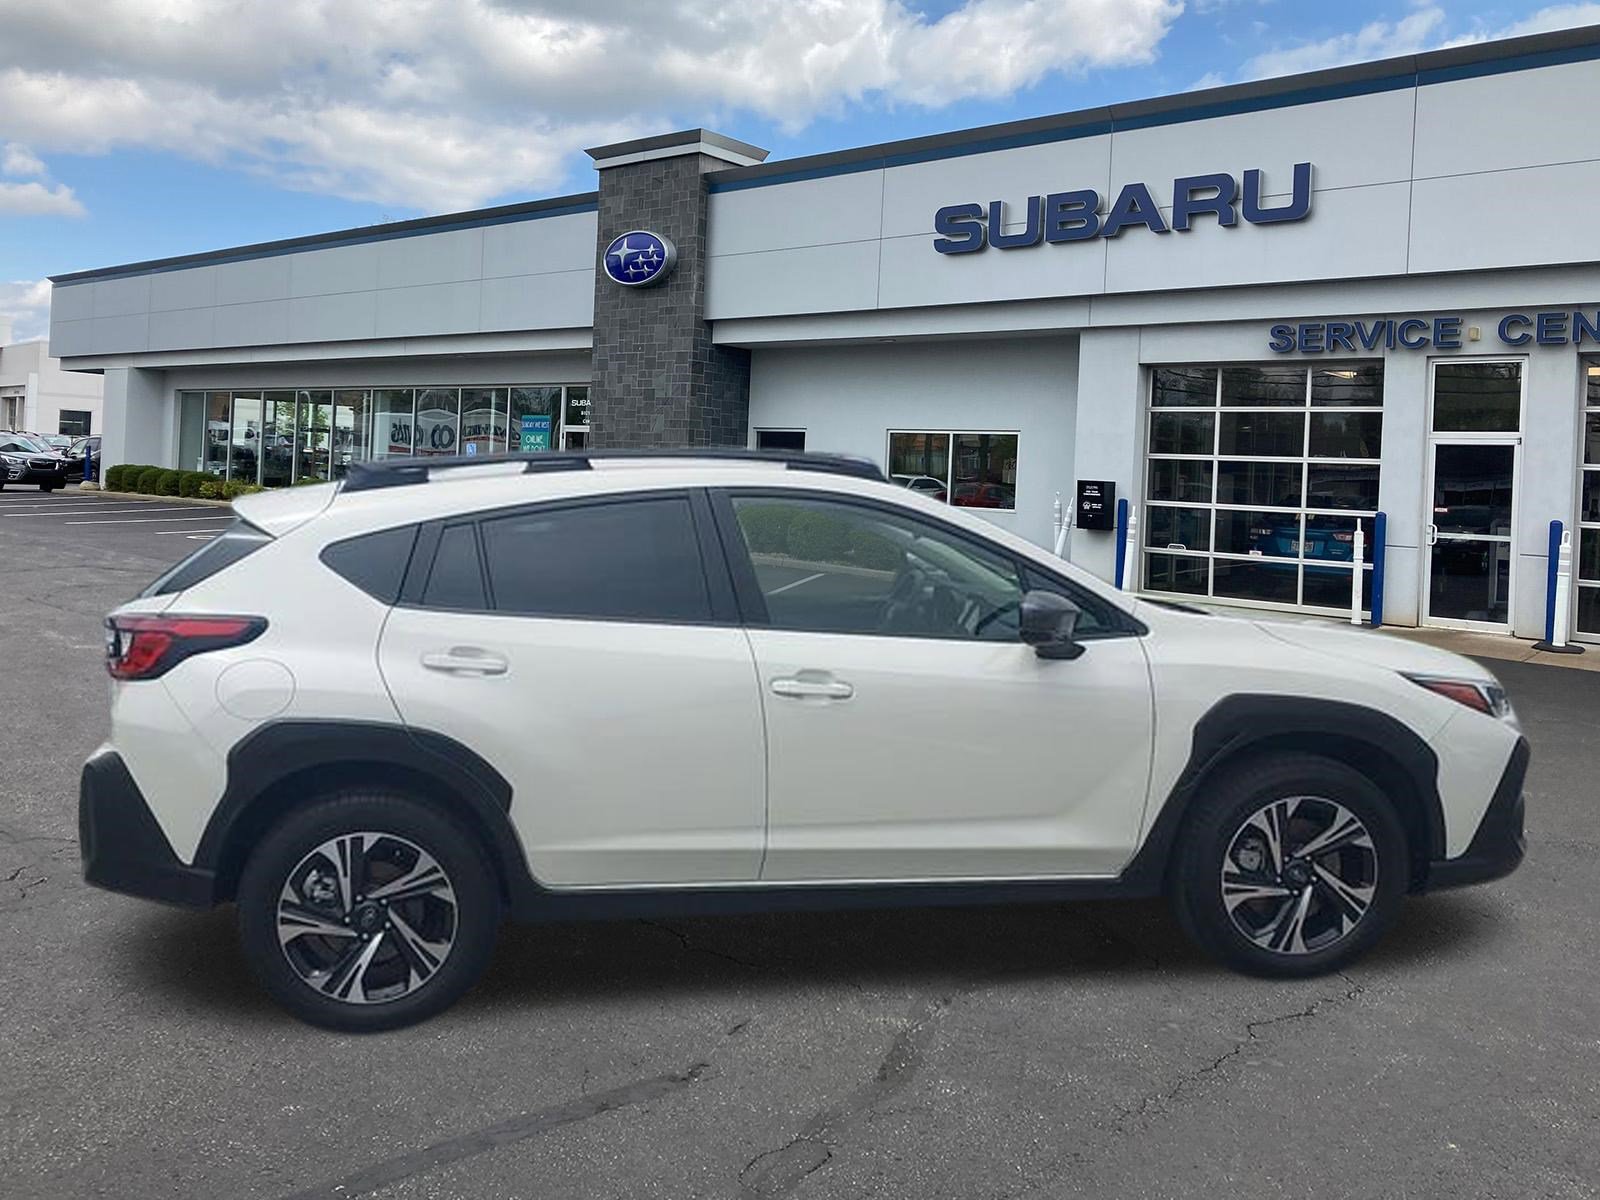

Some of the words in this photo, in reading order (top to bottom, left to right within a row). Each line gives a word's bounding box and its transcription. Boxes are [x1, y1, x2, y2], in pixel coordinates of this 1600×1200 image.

[934, 162, 1313, 255] SUBARU
[1268, 317, 1464, 352] SERVICE
[571, 399, 592, 407] SUBA
